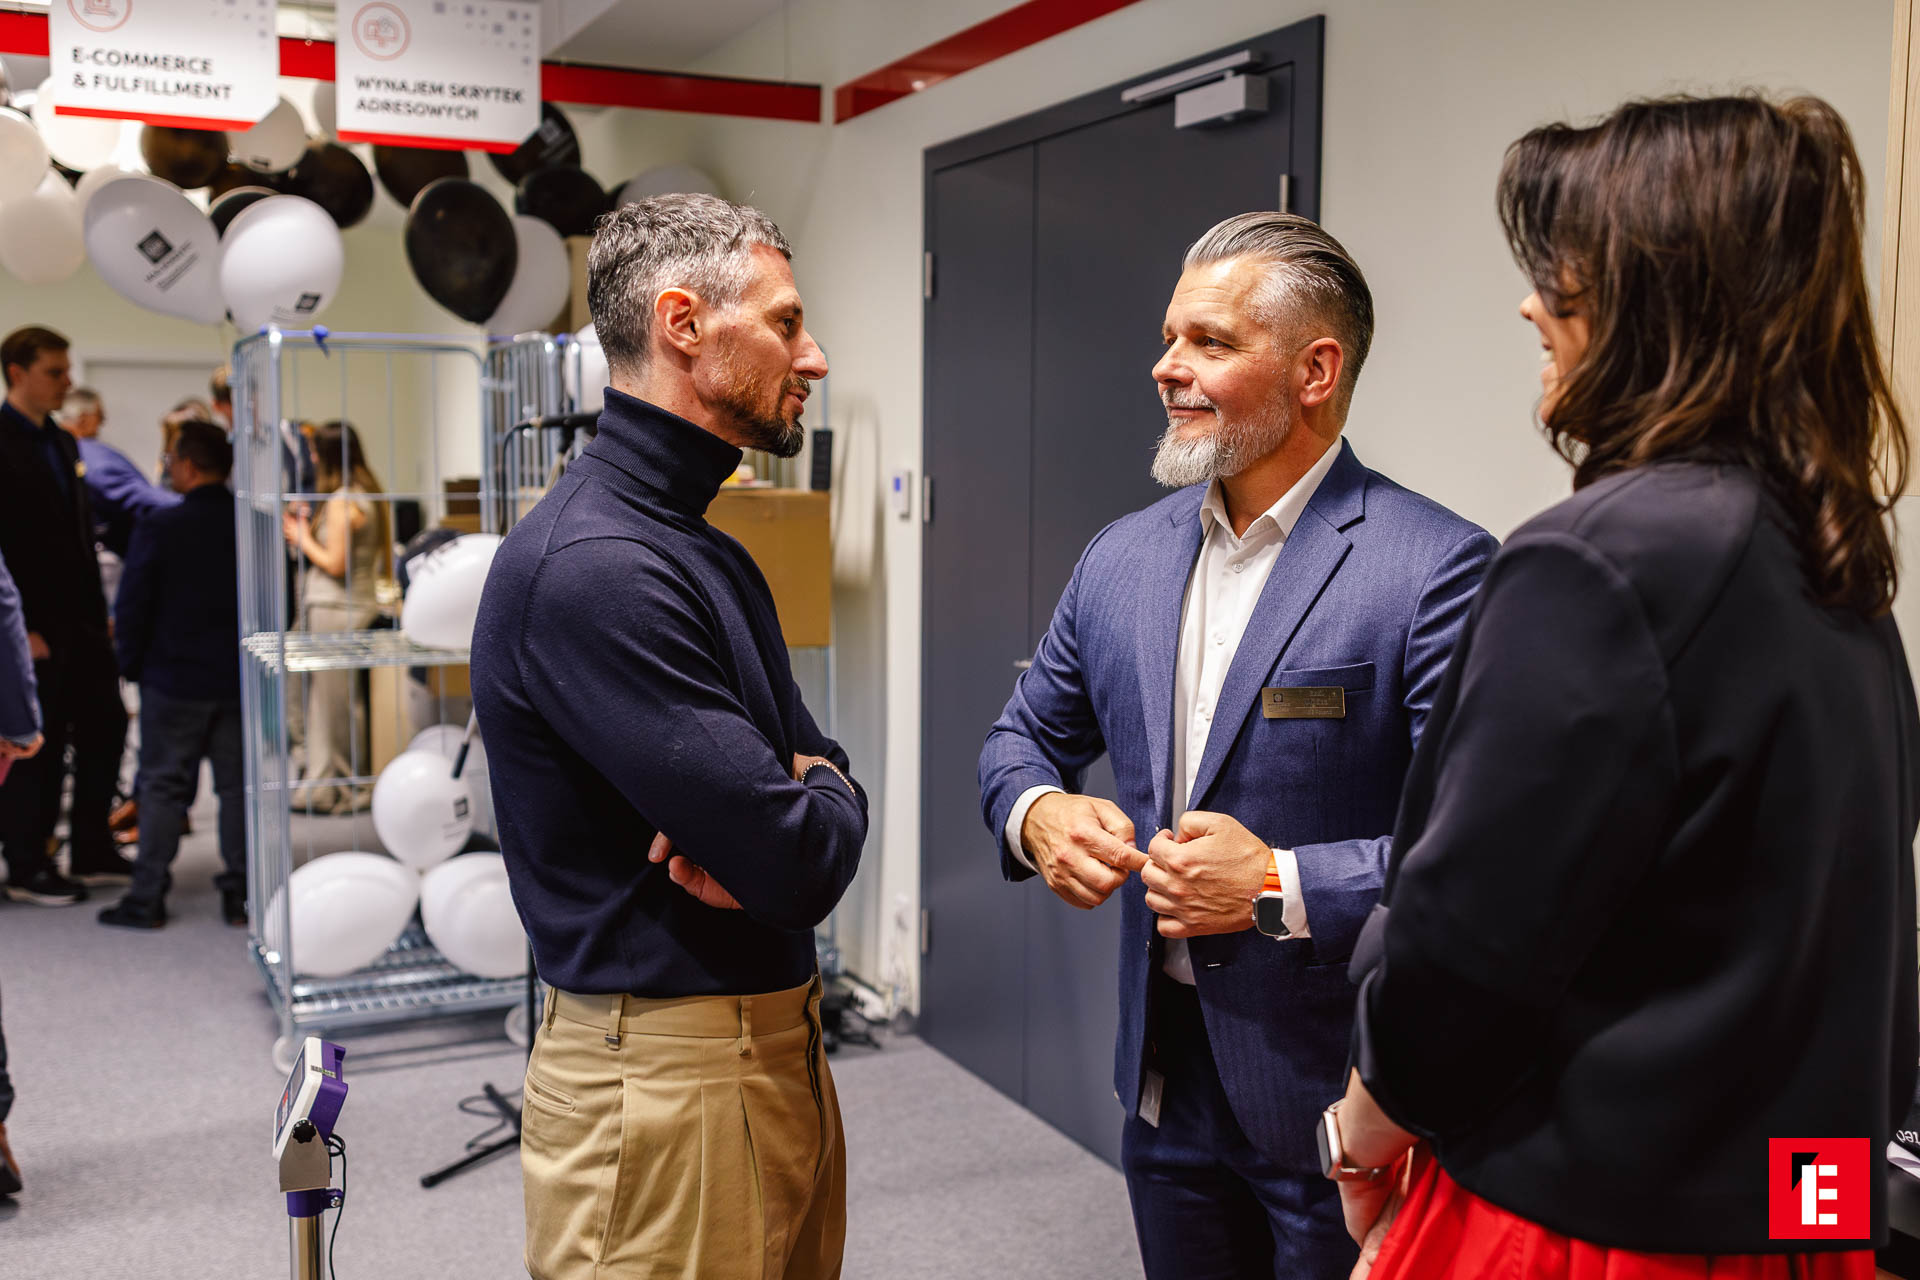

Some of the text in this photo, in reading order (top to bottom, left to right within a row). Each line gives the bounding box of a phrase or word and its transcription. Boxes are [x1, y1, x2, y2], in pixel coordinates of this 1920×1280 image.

[72, 48, 213, 74] E-COMMERCE
[73, 73, 233, 100] & FULFILLMENT
[356, 77, 525, 103] WYNAJEM SKRYTEK
[356, 98, 480, 120] ADRESOWYCH
